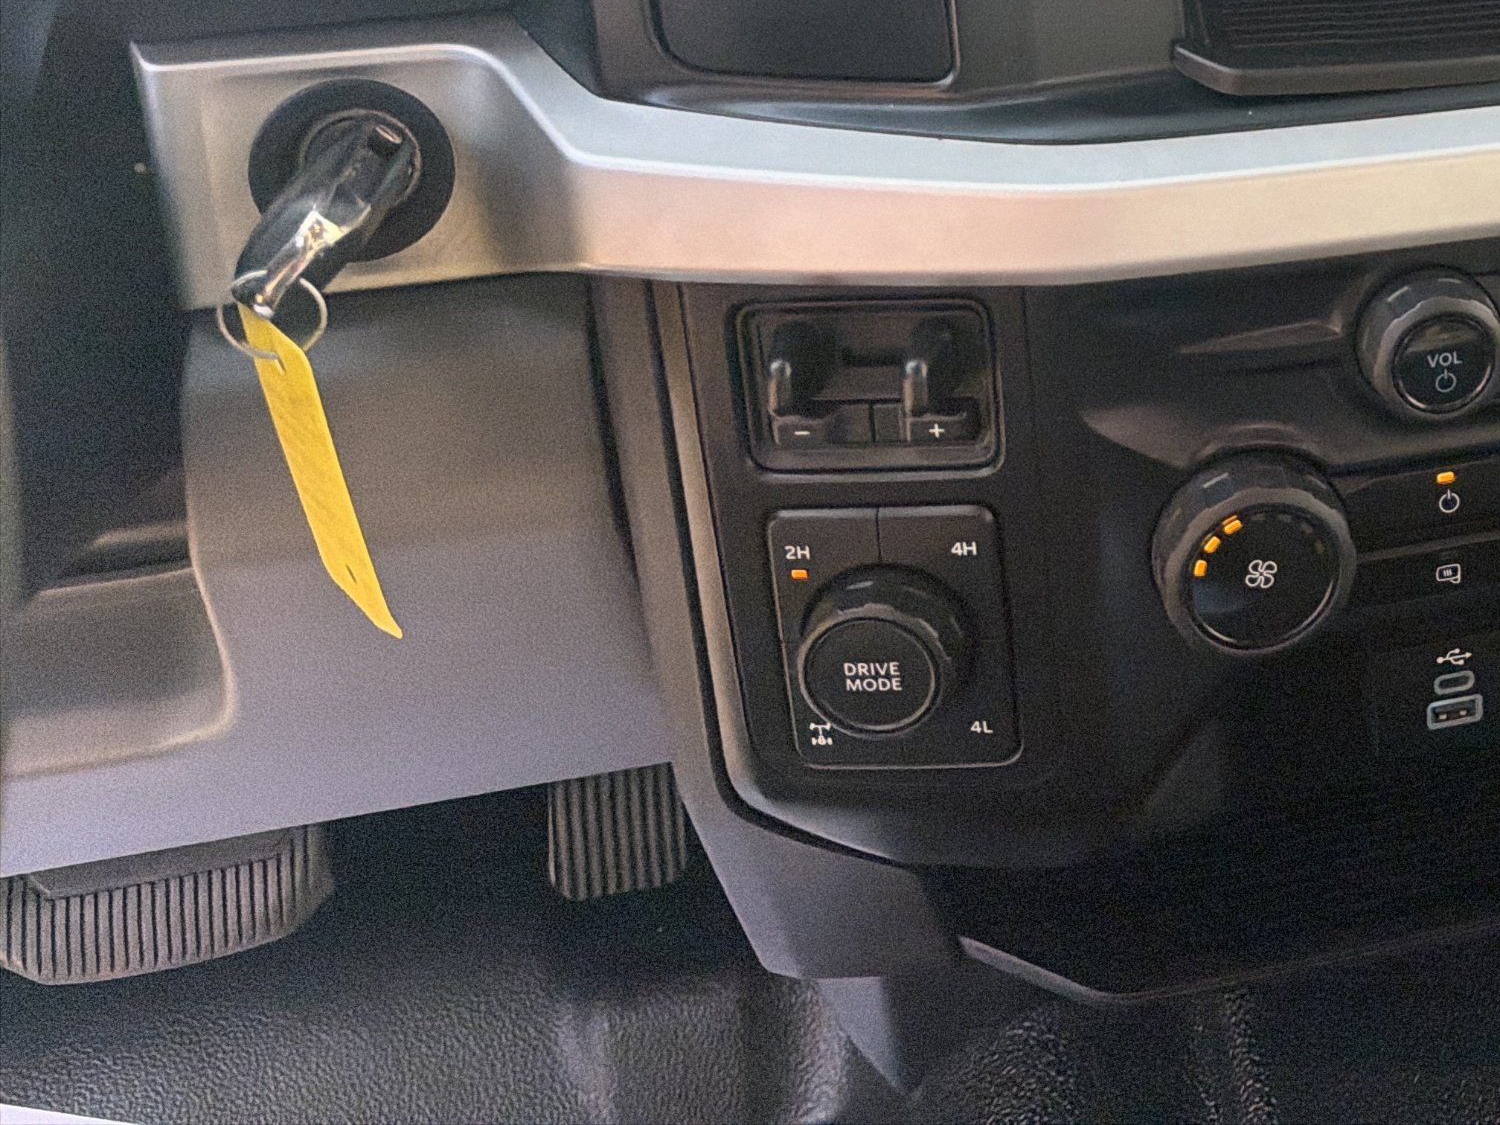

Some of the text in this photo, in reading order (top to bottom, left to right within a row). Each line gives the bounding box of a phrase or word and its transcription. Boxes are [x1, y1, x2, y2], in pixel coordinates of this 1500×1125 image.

[1427, 352, 1463, 368] VOL
[785, 545, 811, 560] 2H
[951, 541, 978, 556] 4H
[843, 661, 901, 677] DRIVE
[846, 677, 903, 692] MODE
[970, 720, 994, 735] 4L
